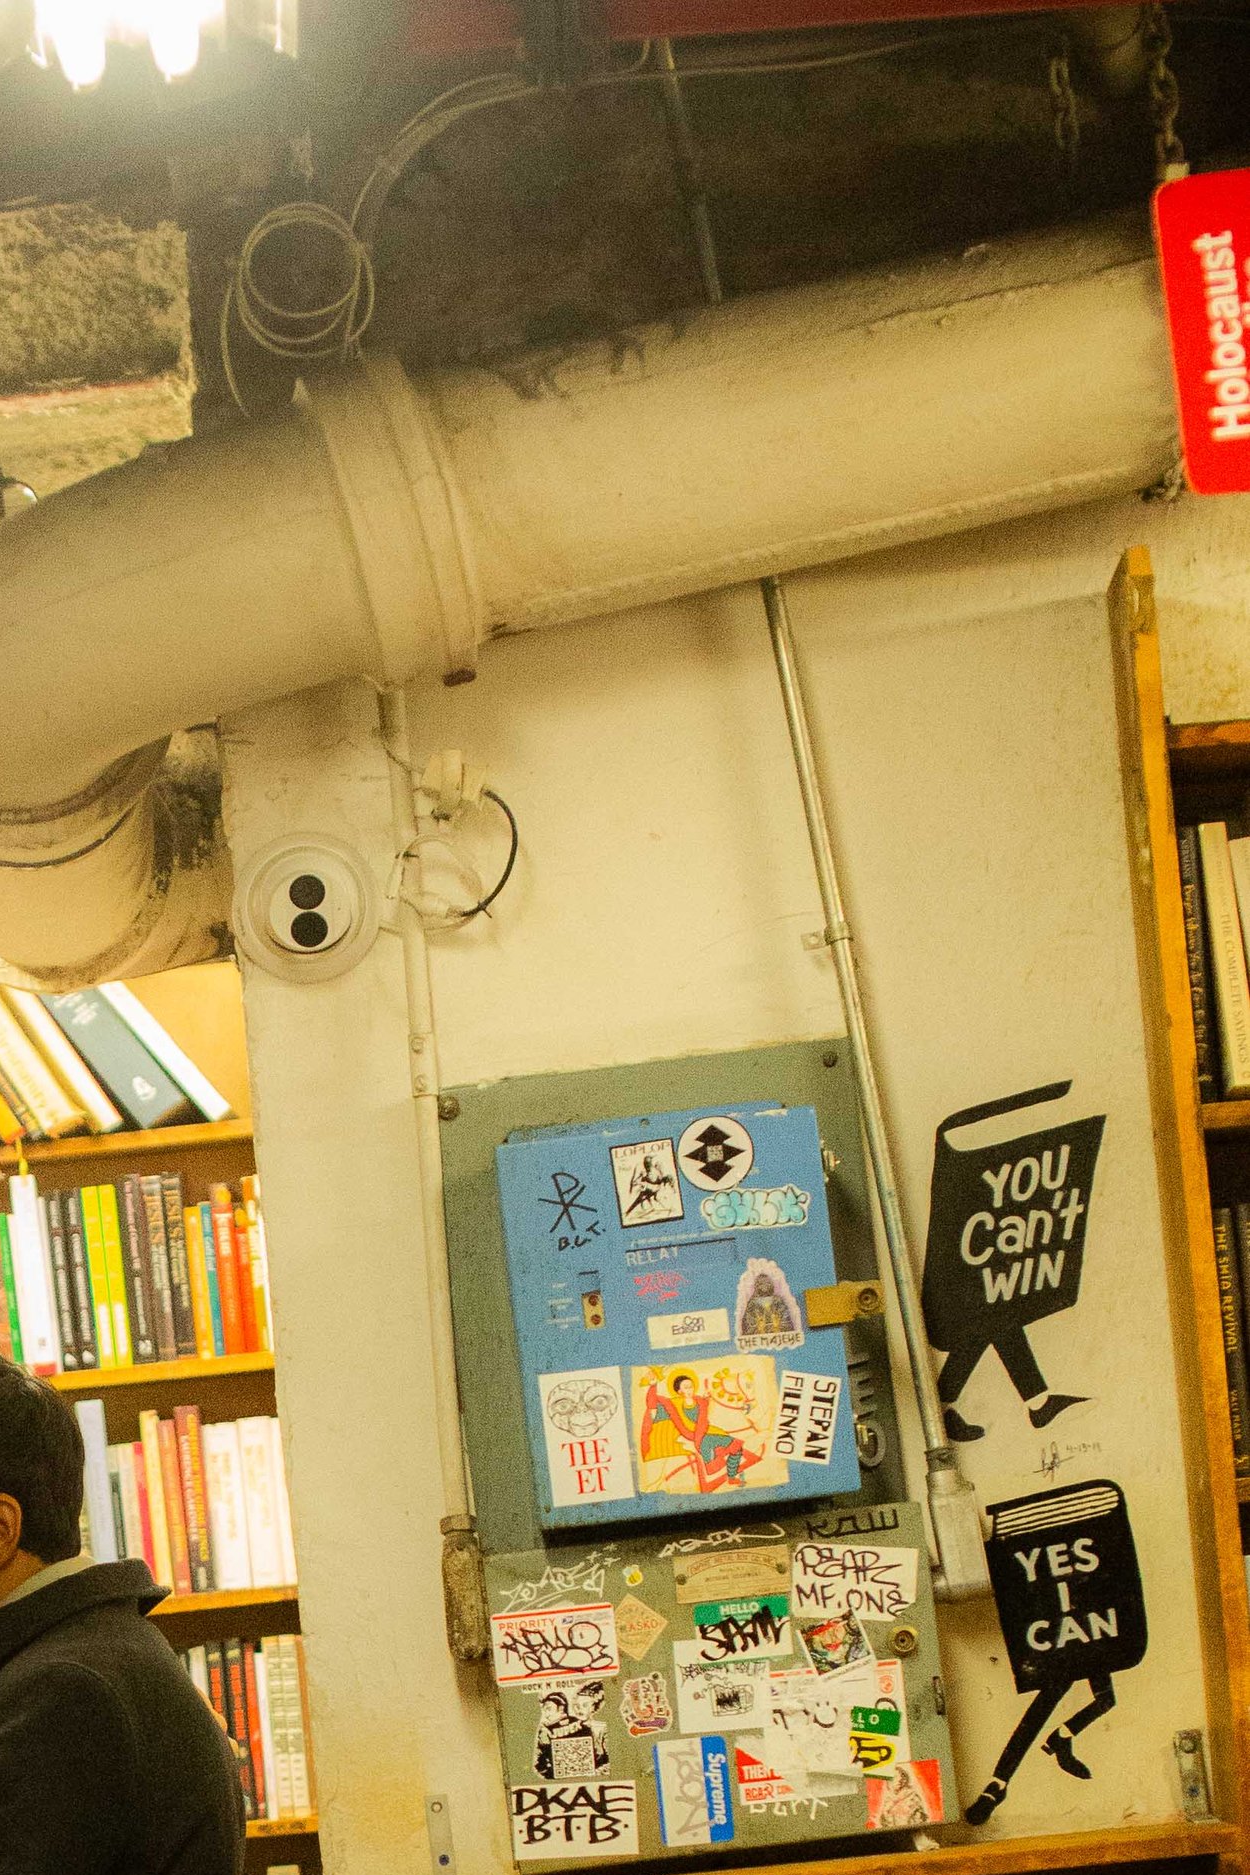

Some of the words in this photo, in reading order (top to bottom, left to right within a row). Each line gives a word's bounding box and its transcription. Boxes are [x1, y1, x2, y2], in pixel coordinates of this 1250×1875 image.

[1191, 229, 1250, 441] Holocaust
[1220, 913, 1232, 936] THE
[1224, 939, 1241, 1007] COMPLETE
[1232, 1011, 1248, 1064] SAYINGS
[981, 1143, 1070, 1209] YOU
[960, 1187, 1084, 1267] Can't
[981, 1249, 1067, 1304] WIN
[1215, 1224, 1227, 1251] THE
[1222, 1296, 1238, 1353] REVIVAL
[775, 1374, 806, 1456] FILENKO
[804, 1379, 838, 1462] STEPAN
[561, 1438, 613, 1469] THE
[575, 1465, 610, 1496] ET
[1014, 1536, 1101, 1583] YES
[719, 1602, 760, 1616] HELLO
[1056, 1580, 1071, 1613] I
[498, 1617, 556, 1633] PRIORITY
[1025, 1607, 1120, 1652] CAN
[703, 1751, 728, 1826] Supreme
